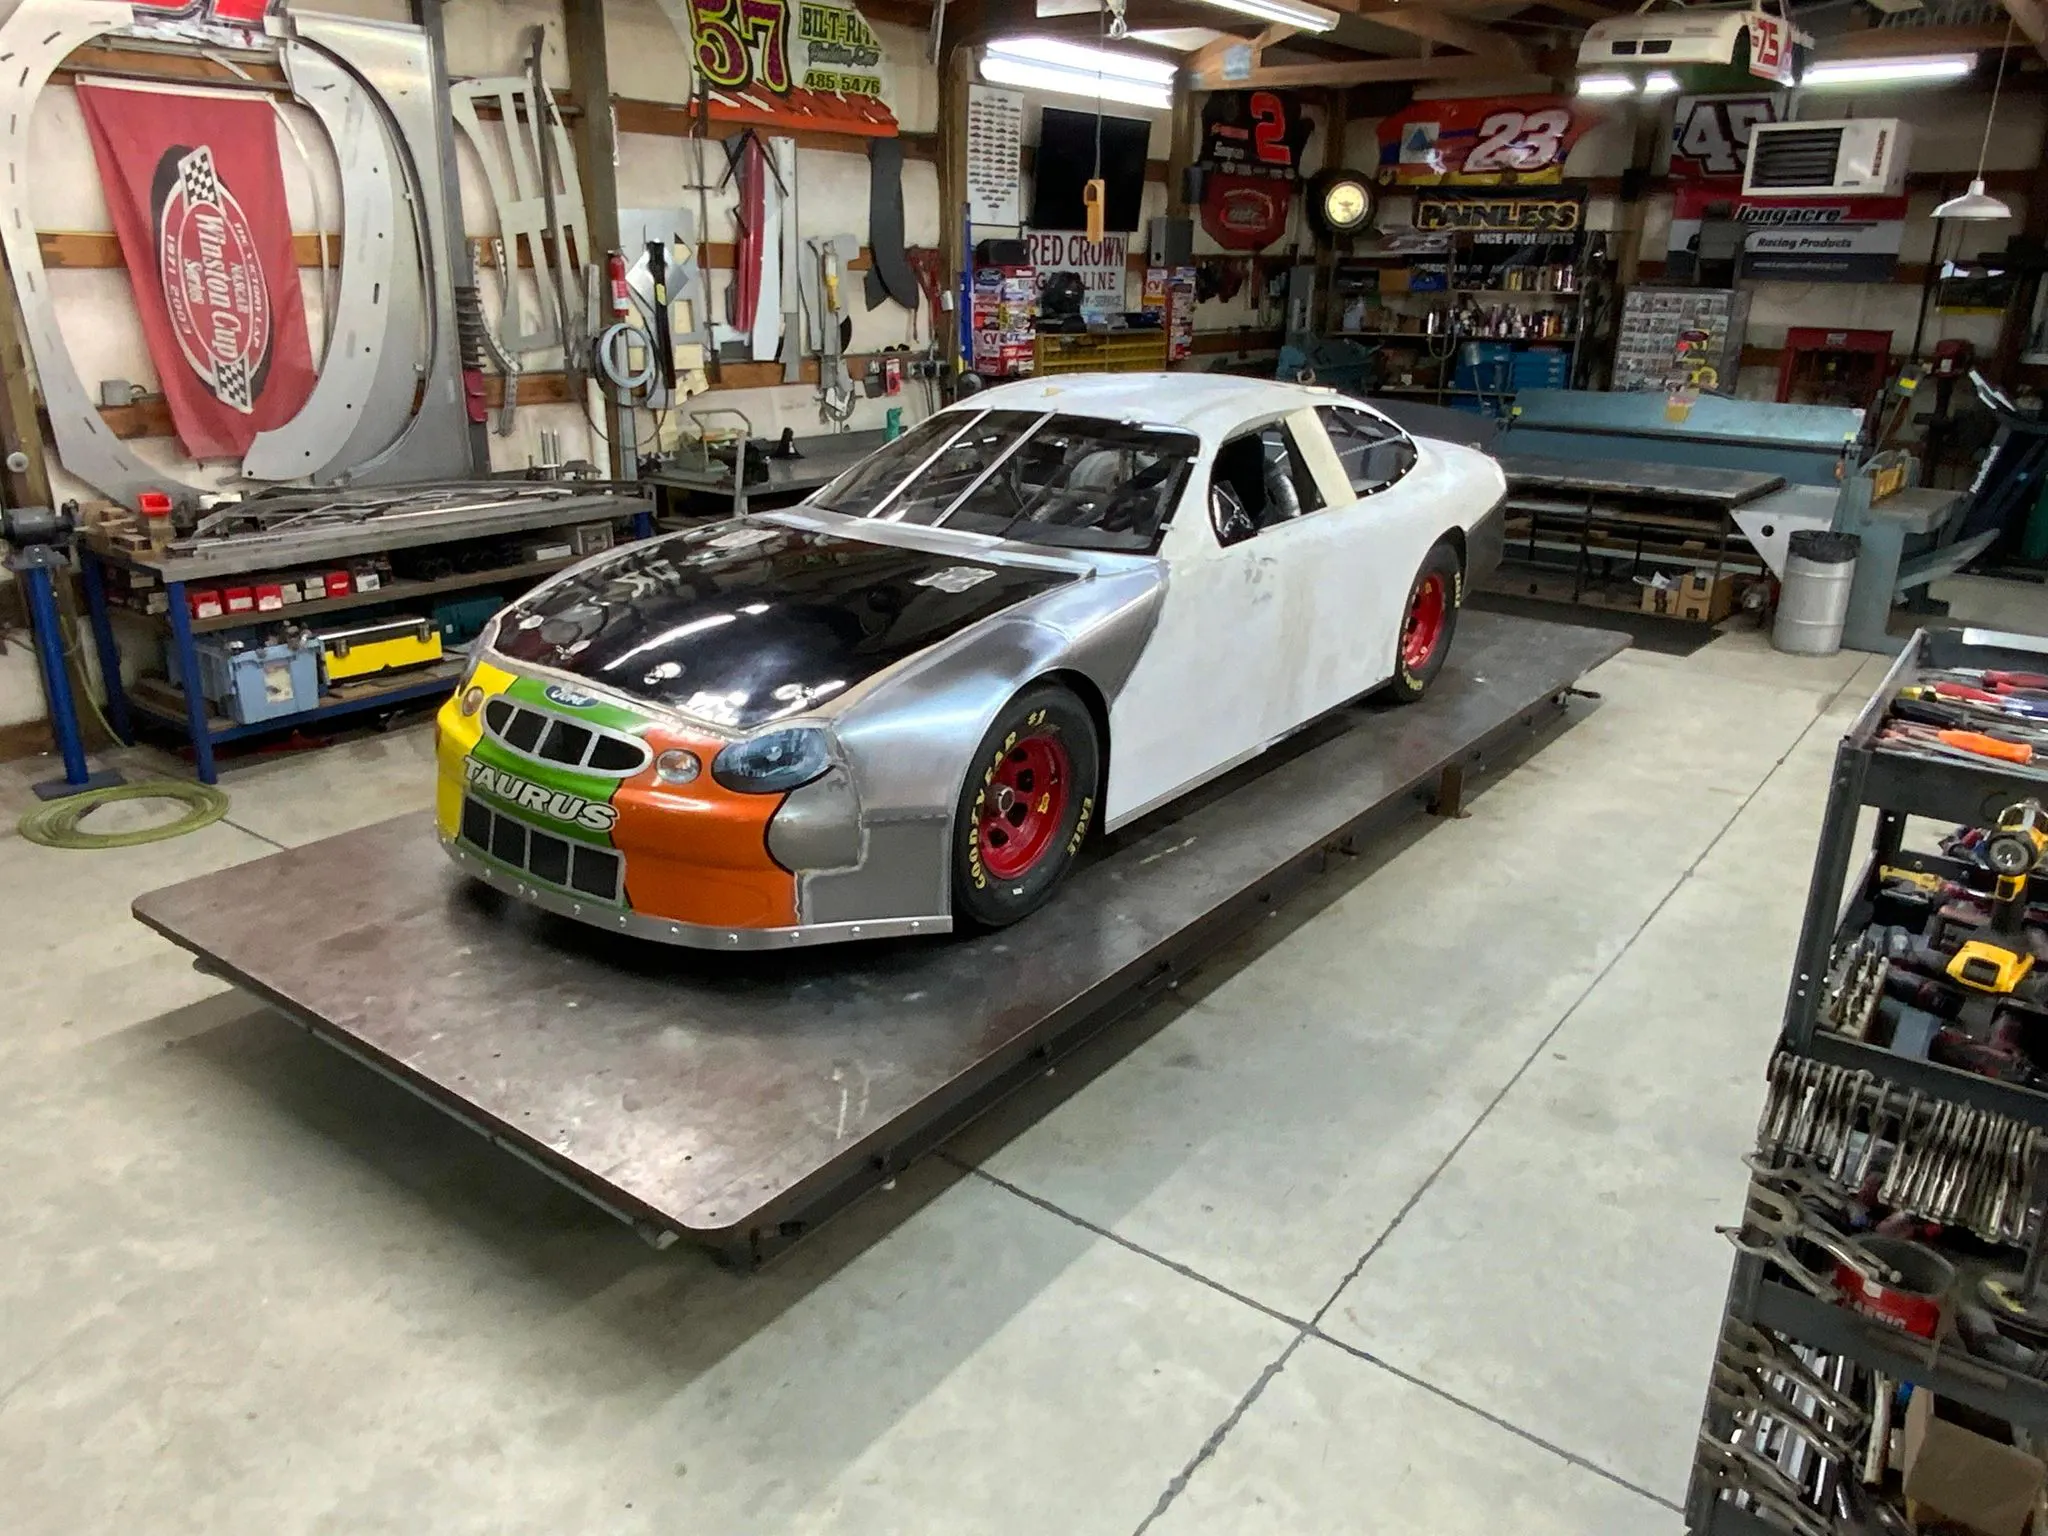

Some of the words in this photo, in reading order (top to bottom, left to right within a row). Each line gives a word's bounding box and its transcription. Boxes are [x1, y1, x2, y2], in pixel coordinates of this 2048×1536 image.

[690, 0, 789, 96] 57
[802, 7, 879, 46] BILT-RIT
[1758, 17, 1779, 67] 75
[1250, 91, 1291, 165] 2
[1462, 109, 1571, 172] 23
[1420, 201, 1579, 230] PAINLESS
[195, 213, 230, 307] Winston
[1027, 234, 1064, 267] RED
[1068, 235, 1125, 267] CROWN
[1757, 237, 1797, 250] Racing
[1799, 237, 1852, 249] Products
[184, 258, 205, 305] Series
[1035, 271, 1116, 291] GLINE
[211, 310, 242, 359] Cup
[464, 754, 621, 832] TAURUS
[968, 731, 1017, 890] GOODYEAR
[1066, 796, 1092, 857] EAGLE
